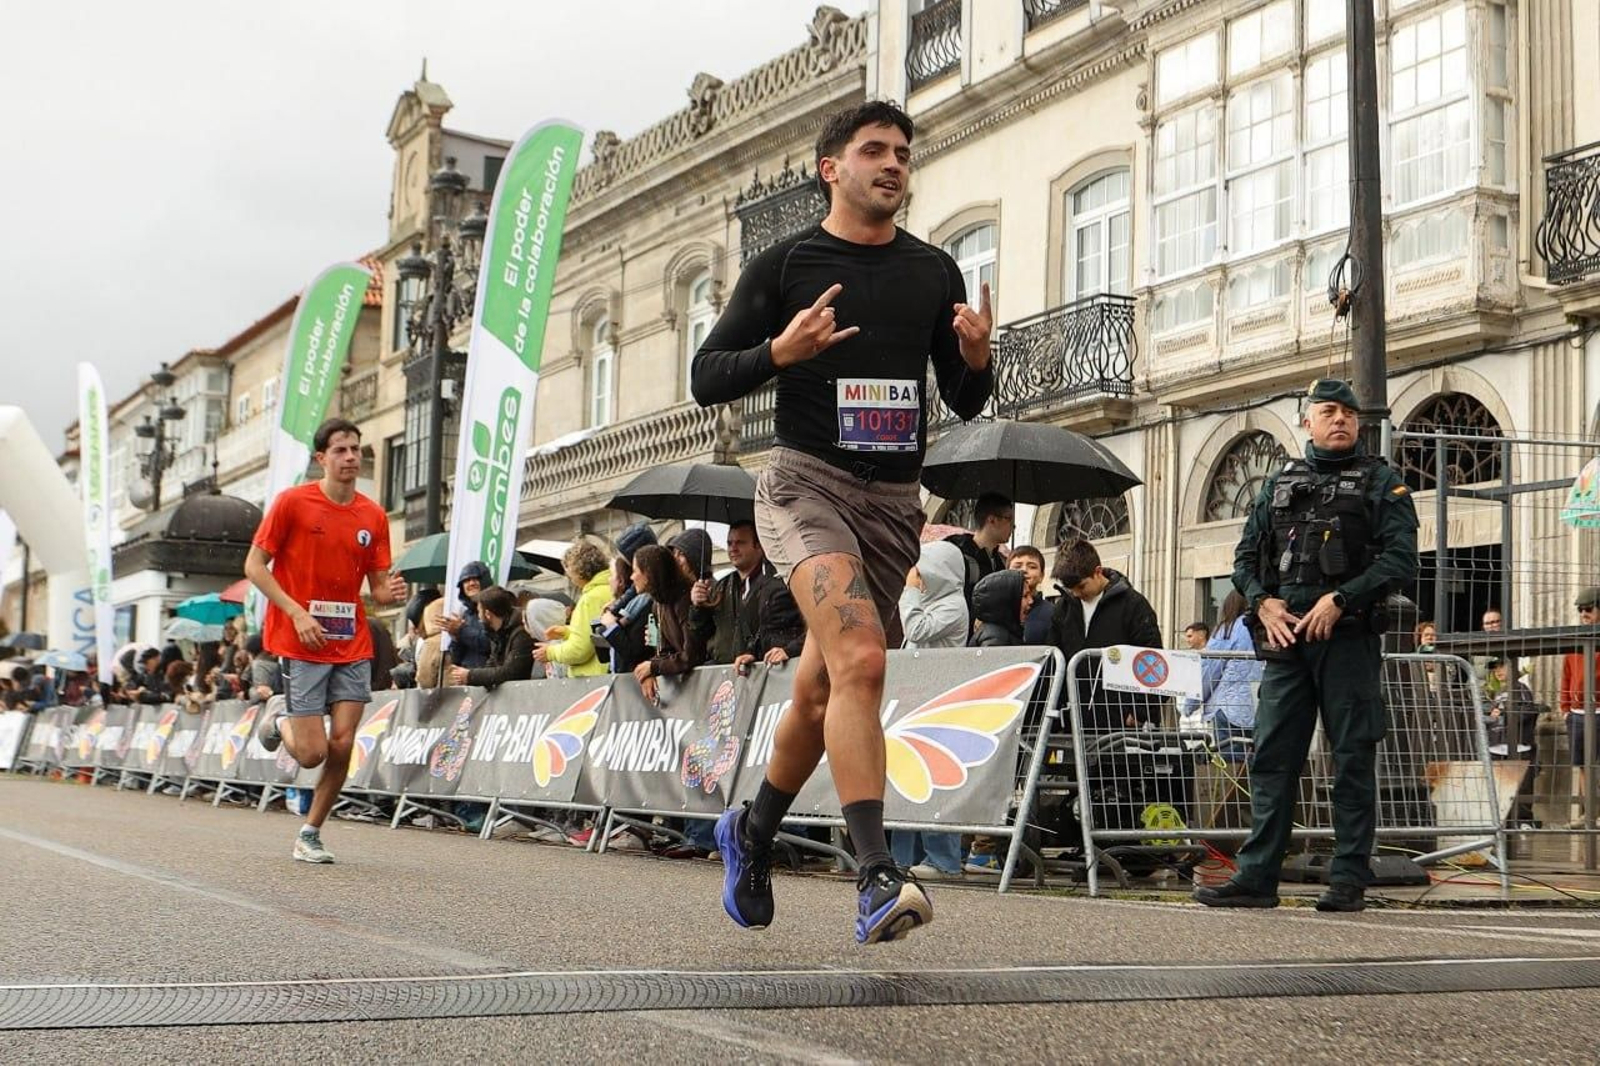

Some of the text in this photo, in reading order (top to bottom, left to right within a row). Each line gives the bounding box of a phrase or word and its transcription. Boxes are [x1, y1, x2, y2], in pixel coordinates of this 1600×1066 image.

[503, 187, 533, 287] El poder
[514, 145, 566, 354] de la colaboración
[298, 318, 325, 396] El poder
[592, 718, 695, 772] MINIBAY
